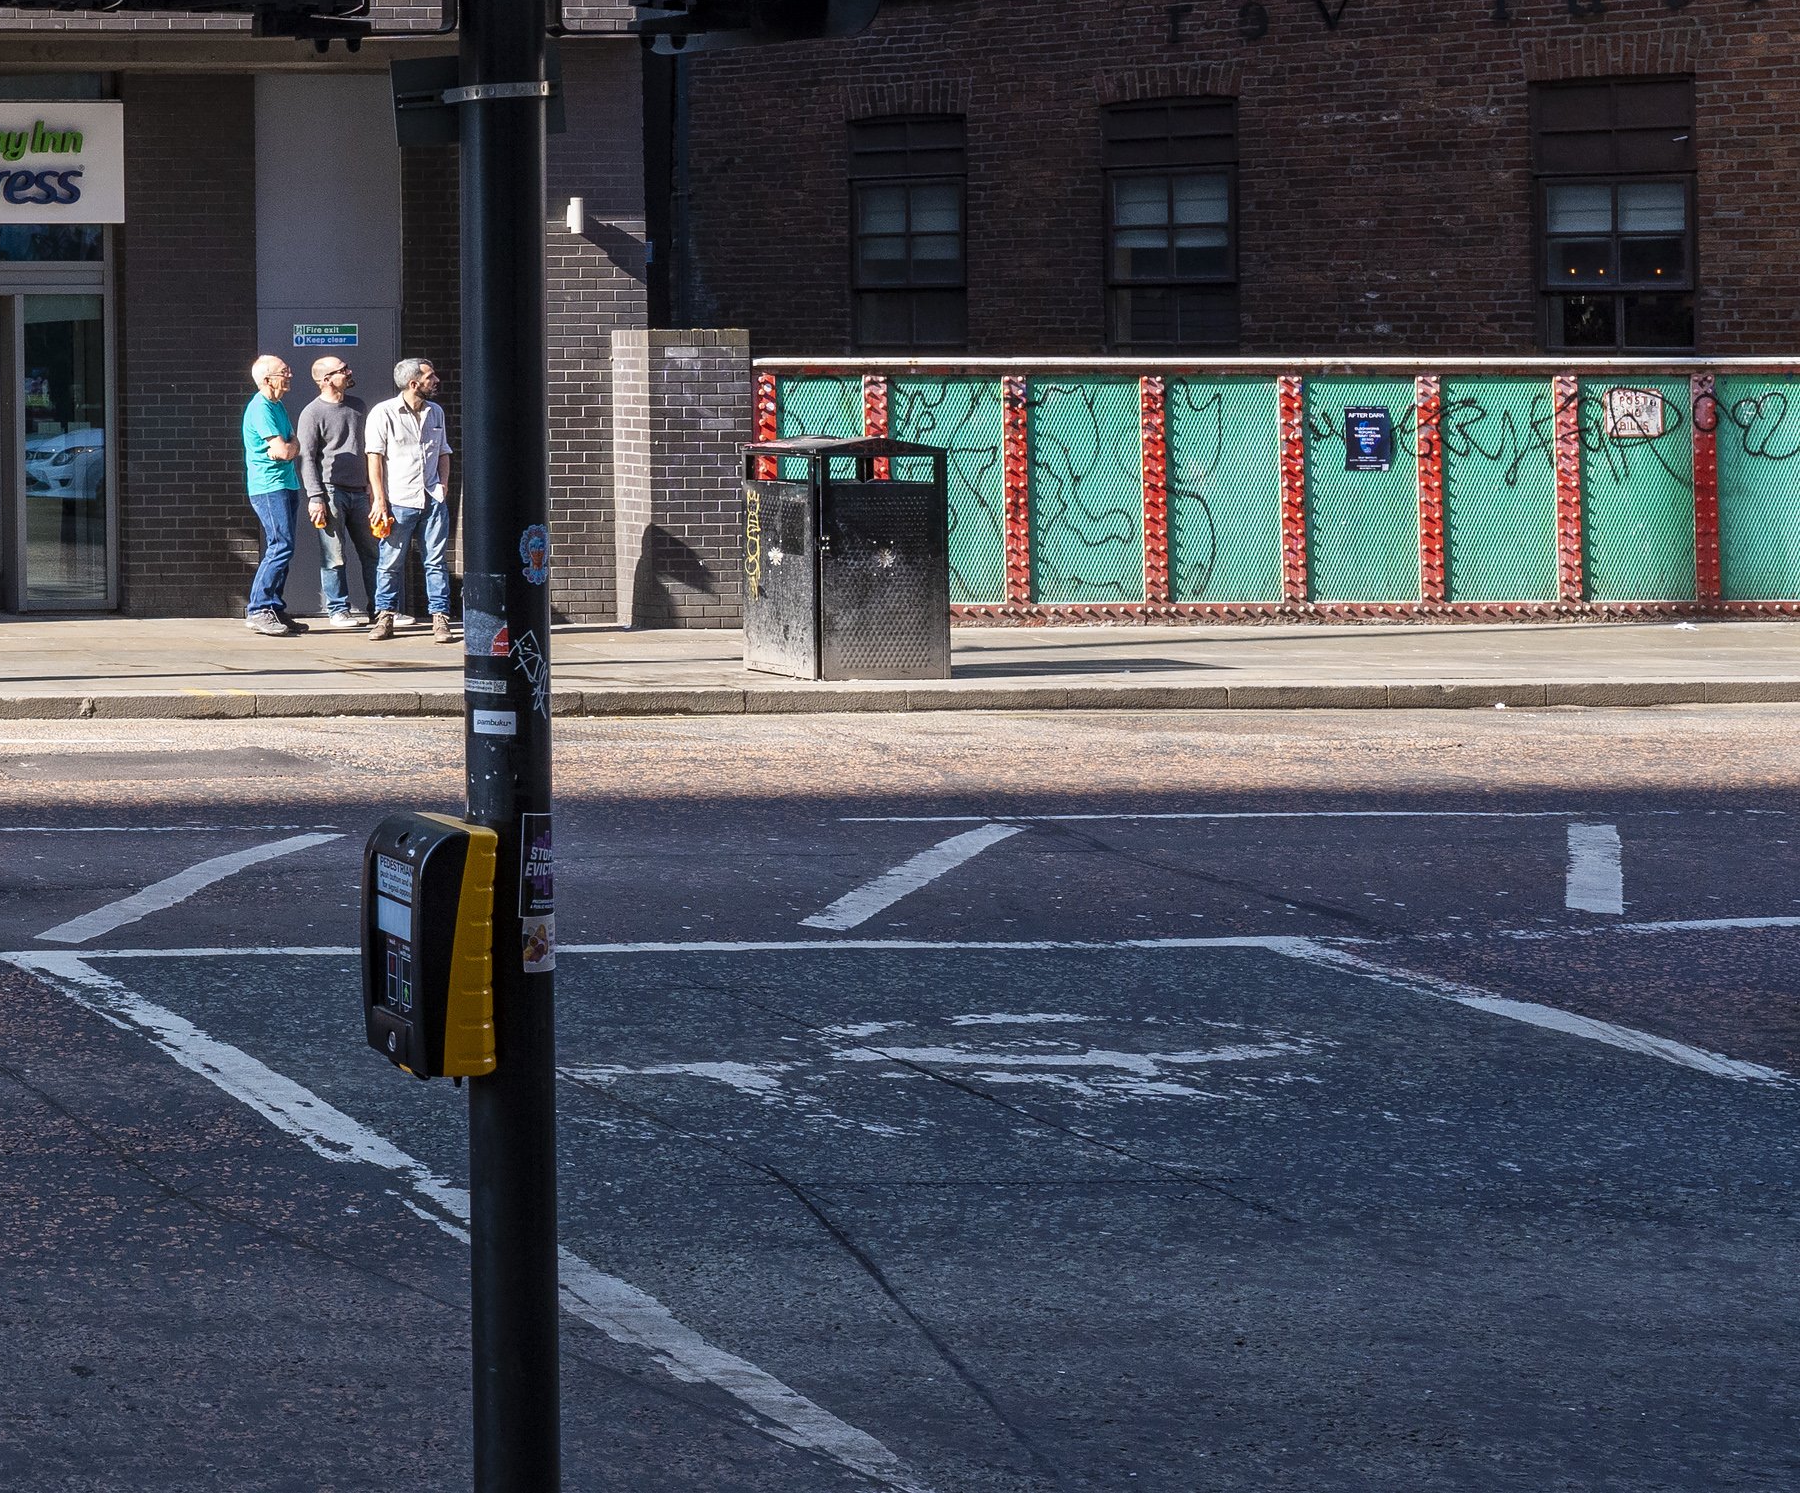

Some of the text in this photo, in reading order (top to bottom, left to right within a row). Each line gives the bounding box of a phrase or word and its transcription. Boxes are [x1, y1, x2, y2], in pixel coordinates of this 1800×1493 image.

[31, 120, 83, 154] Inn
[306, 326, 340, 334] Fire exit
[306, 336, 325, 344] Keep
[1620, 396, 1647, 405] POST
[1626, 407, 1642, 418] NO
[530, 846, 552, 861] STOP
